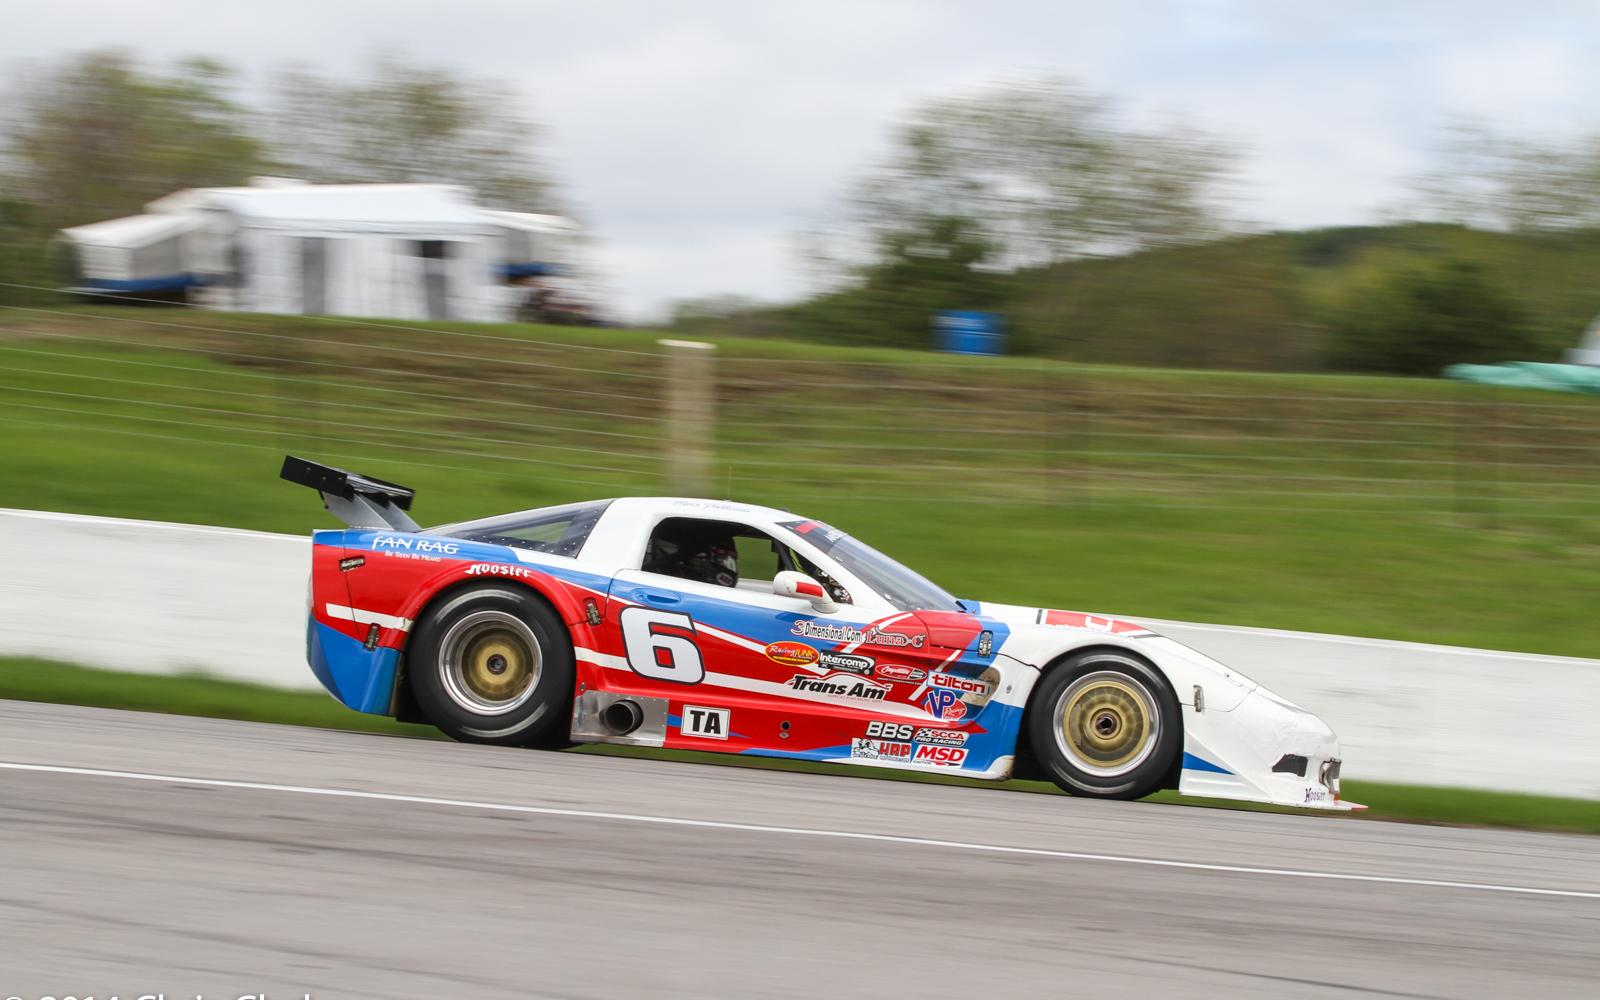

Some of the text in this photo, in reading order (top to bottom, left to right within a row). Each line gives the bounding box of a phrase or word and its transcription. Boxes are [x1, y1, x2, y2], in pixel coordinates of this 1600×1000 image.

[416, 540, 460, 554] RAG
[620, 605, 706, 686] 6
[820, 652, 868, 670] Intercomp
[792, 675, 848, 695] Trans
[847, 682, 885, 700] Am
[931, 673, 985, 693] tilton
[928, 690, 956, 719] VP
[690, 710, 721, 734] TA
[865, 721, 914, 740] BBS
[931, 731, 964, 739] SCCA
[932, 738, 963, 746] RACING
[916, 745, 965, 762] MSD
